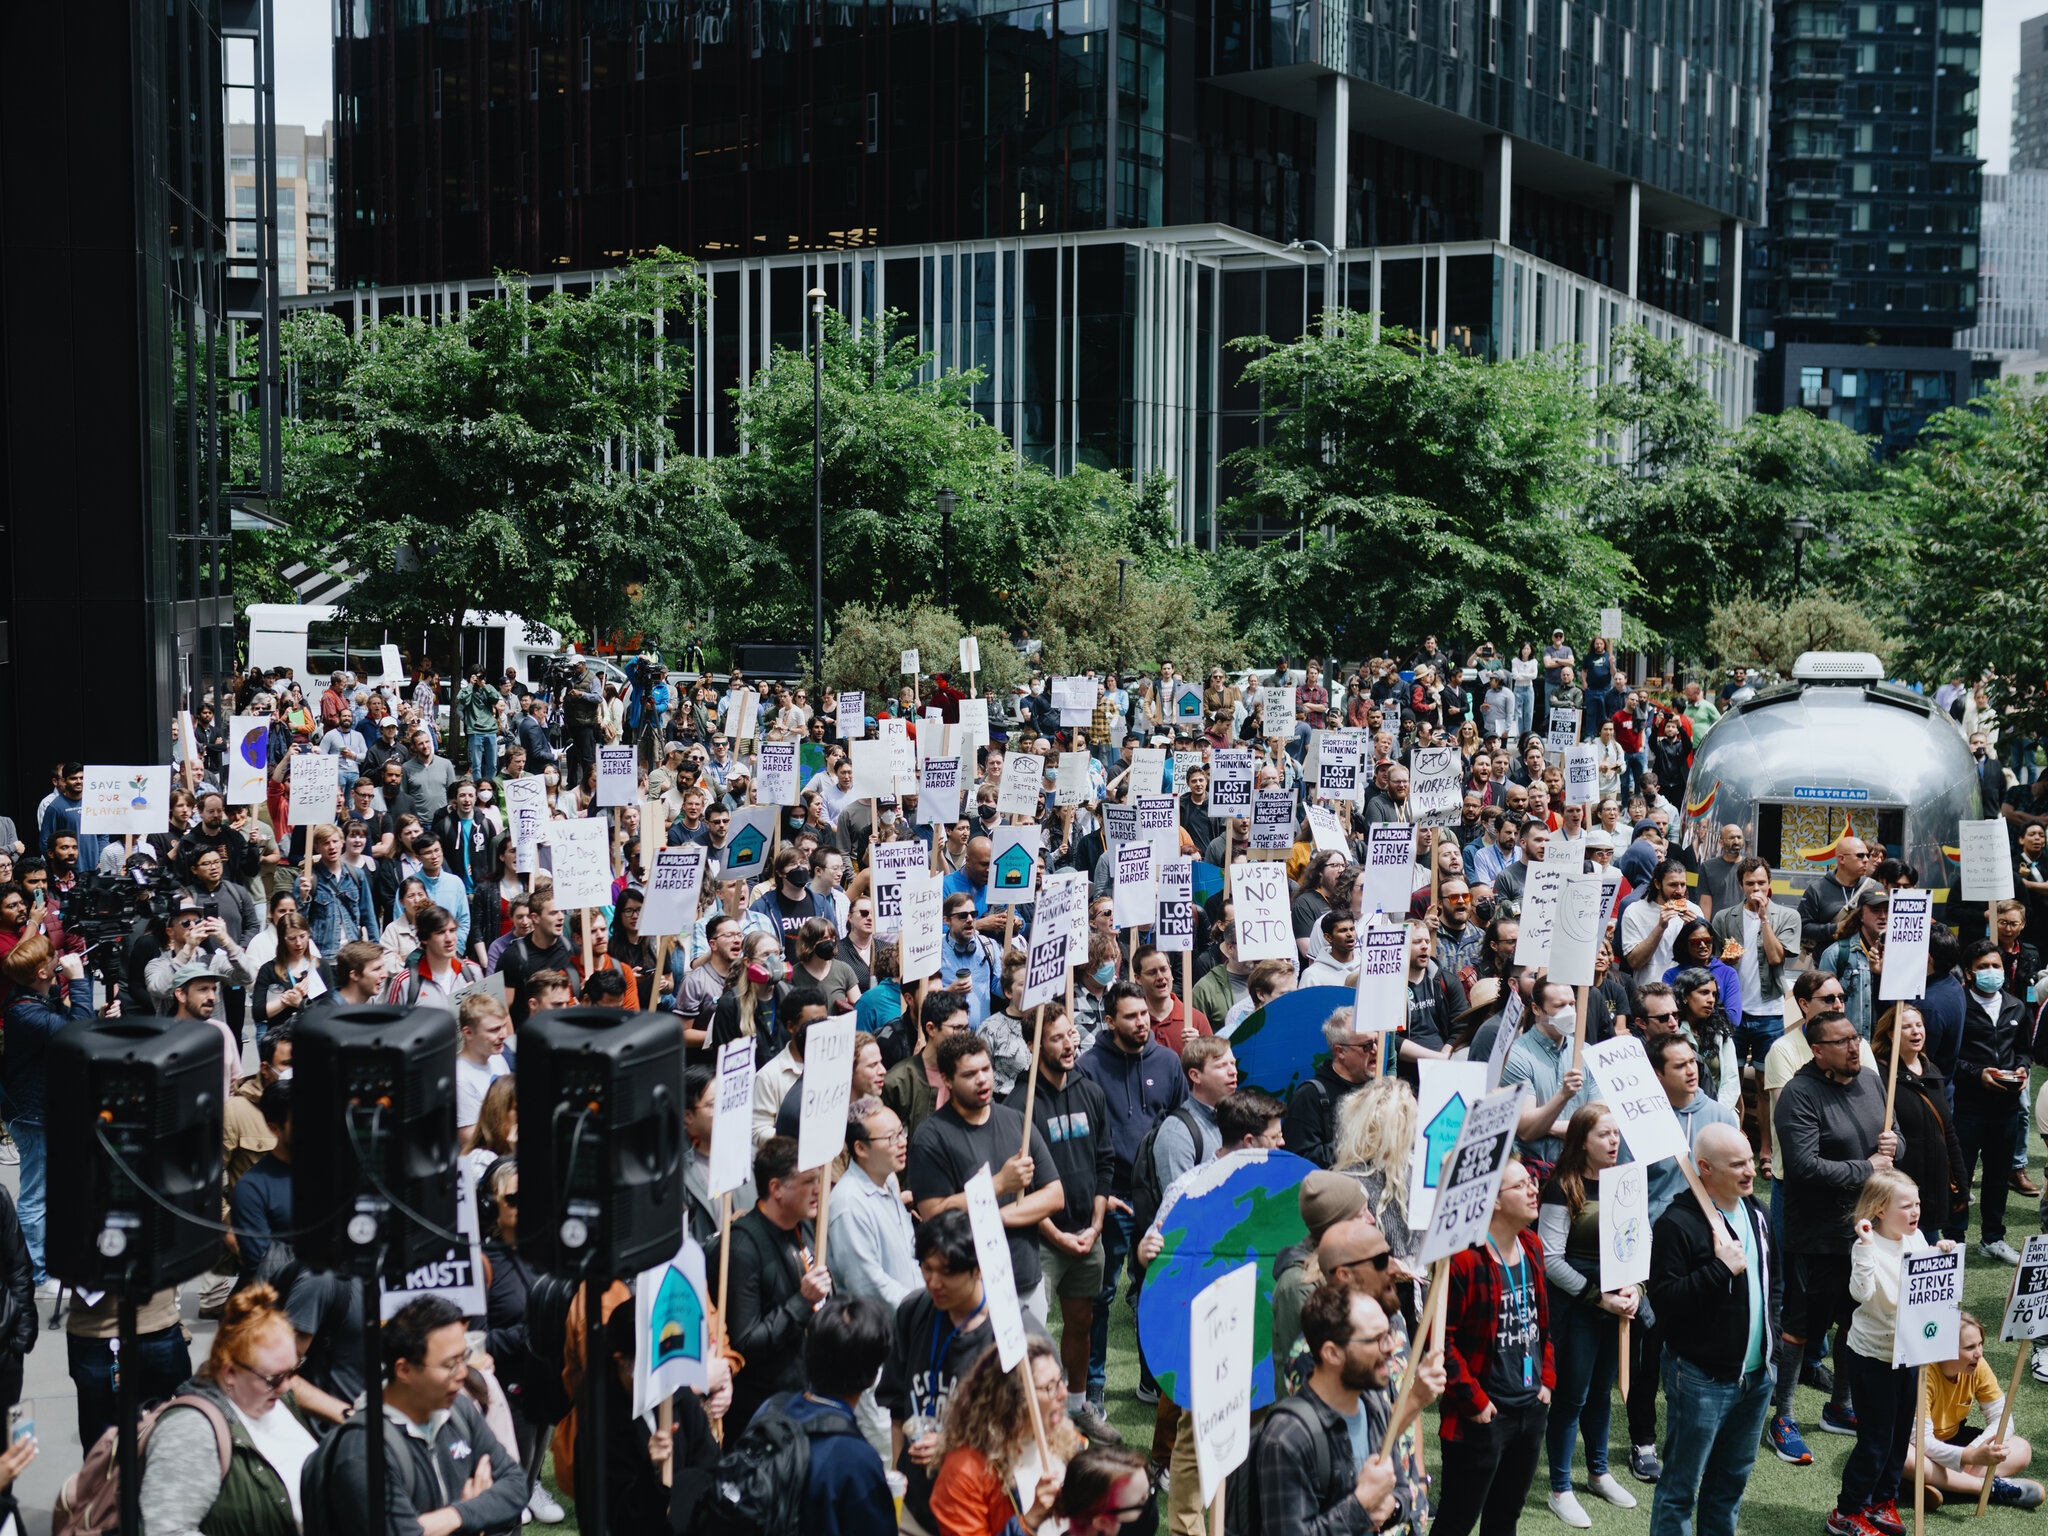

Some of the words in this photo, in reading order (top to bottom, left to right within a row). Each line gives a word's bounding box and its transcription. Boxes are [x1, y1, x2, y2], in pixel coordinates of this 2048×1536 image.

[1551, 738, 1561, 746] TO
[602, 751, 632, 759] AMAZON:
[762, 746, 794, 755] AMAZON:
[1322, 746, 1357, 755] THINKING
[1214, 753, 1252, 761] SHORT-TERM
[294, 758, 330, 769] WHAT
[602, 760, 632, 768] STRIVE
[762, 764, 792, 772] HARDER
[926, 761, 957, 770] AMAZON:
[1215, 761, 1252, 769] THINKING
[602, 768, 632, 776] HARDER
[926, 771, 956, 780] STRIVE
[1324, 766, 1352, 777] LOST
[90, 781, 121, 790] SAVE
[925, 781, 955, 789] HARDER
[1013, 783, 1037, 792] BETTER
[1217, 781, 1247, 793] LOST
[1321, 777, 1354, 788] TRUST
[98, 794, 120, 802] OUR
[1214, 793, 1250, 804] TRUST
[1259, 792, 1290, 800] AMAZON
[1795, 789, 1867, 799] AIRSTREAM
[1140, 801, 1173, 809] AMAZON:
[1419, 796, 1448, 809] MAKE
[86, 807, 129, 817] PLANET
[1109, 810, 1136, 820] AMAZON:
[1140, 811, 1173, 820] STRIVE
[1140, 819, 1173, 829] HARDER
[1256, 815, 1277, 823] SINCE
[1109, 821, 1136, 832] STRIVE
[1109, 831, 1136, 841] HARDER
[1253, 833, 1290, 841] LOWERING
[1374, 829, 1412, 840] AMAZON:
[1272, 840, 1287, 848] BAR
[1372, 843, 1409, 854] STRIVE
[875, 847, 924, 858] SHORT-TERM
[1119, 849, 1149, 861] AMAZON:
[659, 855, 699, 865] AMAZON:
[876, 856, 924, 869] THINKING
[1371, 855, 1408, 866] HARDER
[657, 868, 696, 879] STRIVE
[1119, 861, 1150, 875] STRIVE
[1162, 864, 1191, 873] SHORT-T
[1119, 871, 1150, 884] HARDER
[1161, 873, 1191, 885] THINK
[1237, 866, 1269, 882] JUST
[655, 880, 693, 890] HARDER
[880, 884, 902, 901] LO
[1244, 882, 1277, 902] NO
[1038, 887, 1073, 909] SHORT-TERM
[1037, 899, 1073, 923] THINKING
[1164, 902, 1193, 919] LOS
[1255, 907, 1271, 917] TO
[1895, 902, 1926, 912] AMAZON:
[1161, 918, 1193, 935] TRU
[1892, 916, 1924, 929] STRIVE
[1241, 919, 1287, 945] RTO
[1891, 930, 1922, 943] HARDER
[1368, 934, 1405, 945] AMAZON:
[1032, 937, 1065, 967] LOST
[1367, 948, 1402, 962] STRIVE
[1029, 958, 1066, 985] TRUST
[1366, 962, 1401, 976] HARDER
[810, 1033, 849, 1062] THIN
[723, 1071, 750, 1096] STRIVE
[1611, 1074, 1640, 1092] DO
[805, 1081, 850, 1119] BIGGE
[1462, 1137, 1498, 1166] STOP
[1475, 1156, 1494, 1175] PR
[1442, 1196, 1451, 1211] &
[1453, 1181, 1491, 1207] LISTEN
[1436, 1209, 1458, 1235] TO
[1466, 1199, 1487, 1223] US
[2028, 1243, 2048, 1253] EART
[1912, 1256, 1956, 1273] AMAZON:
[406, 1261, 470, 1290] RUST
[2030, 1267, 2048, 1285] STO
[1910, 1273, 1955, 1291] STRIVE
[2028, 1279, 2044, 1293] THE
[1501, 1287, 1536, 1310] THY
[1909, 1288, 1954, 1306] HARDER
[2016, 1298, 2026, 1310] &
[2026, 1294, 2048, 1309] LISTE
[1498, 1306, 1538, 1329] THEM
[2012, 1309, 2034, 1324] TO
[1203, 1304, 1238, 1347] This
